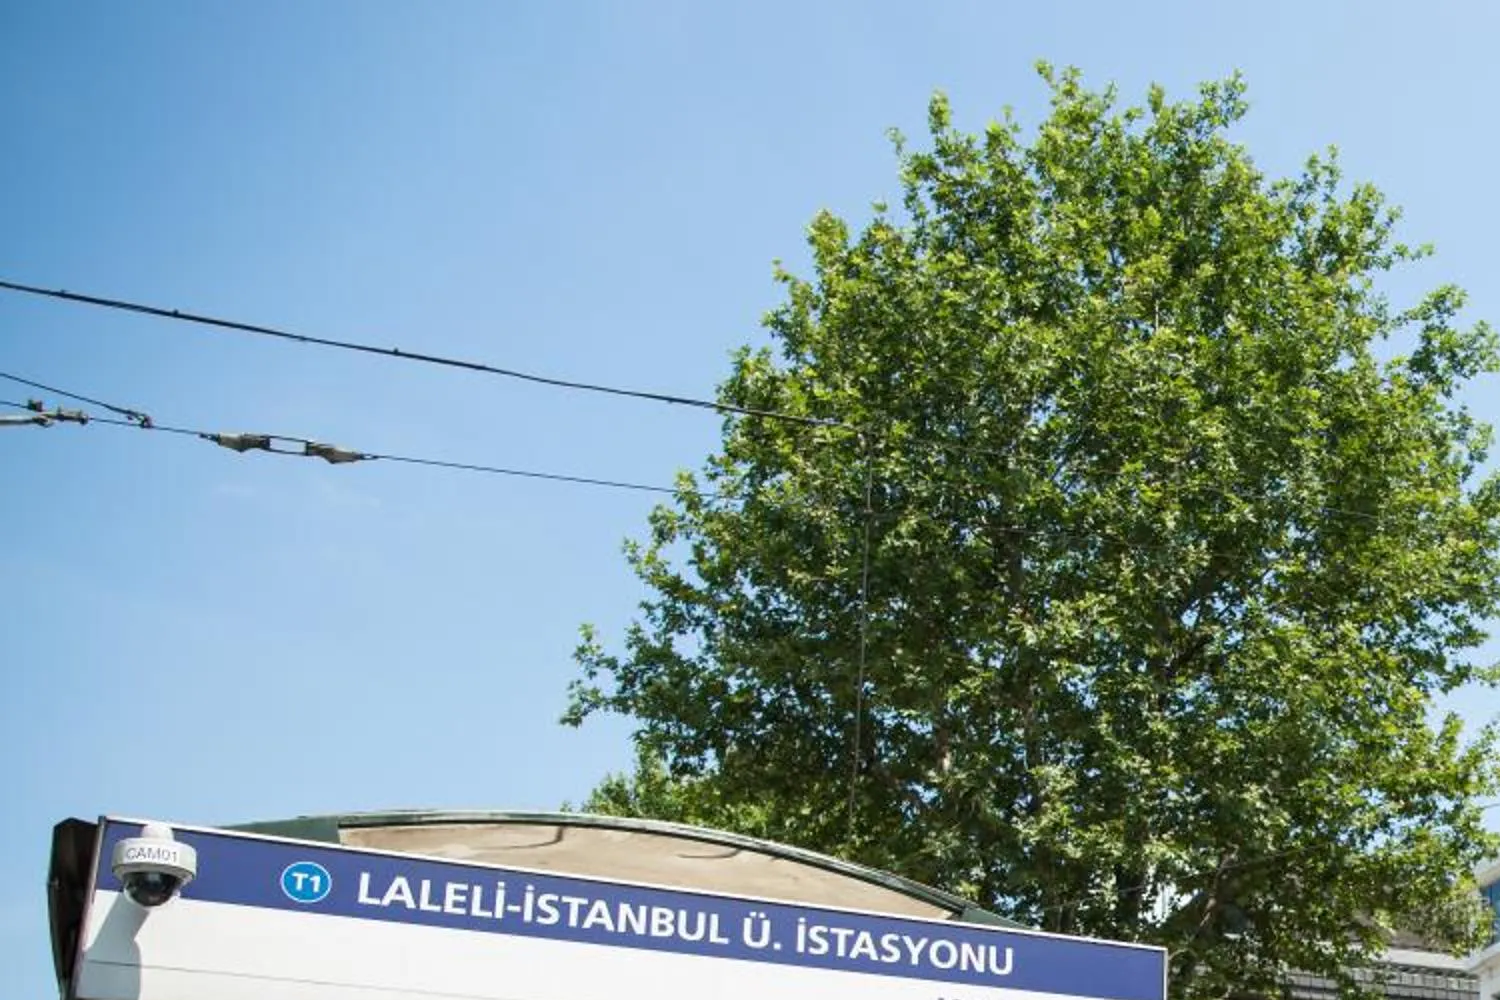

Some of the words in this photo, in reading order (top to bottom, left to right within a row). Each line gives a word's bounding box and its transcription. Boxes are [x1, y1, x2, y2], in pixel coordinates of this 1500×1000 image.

[127, 848, 178, 862] CAM01
[292, 872, 322, 893] T1
[357, 872, 729, 946] LALELİ-İSTANBUL
[743, 913, 781, 950] Ü.
[796, 916, 1013, 975] İSTASYONU
